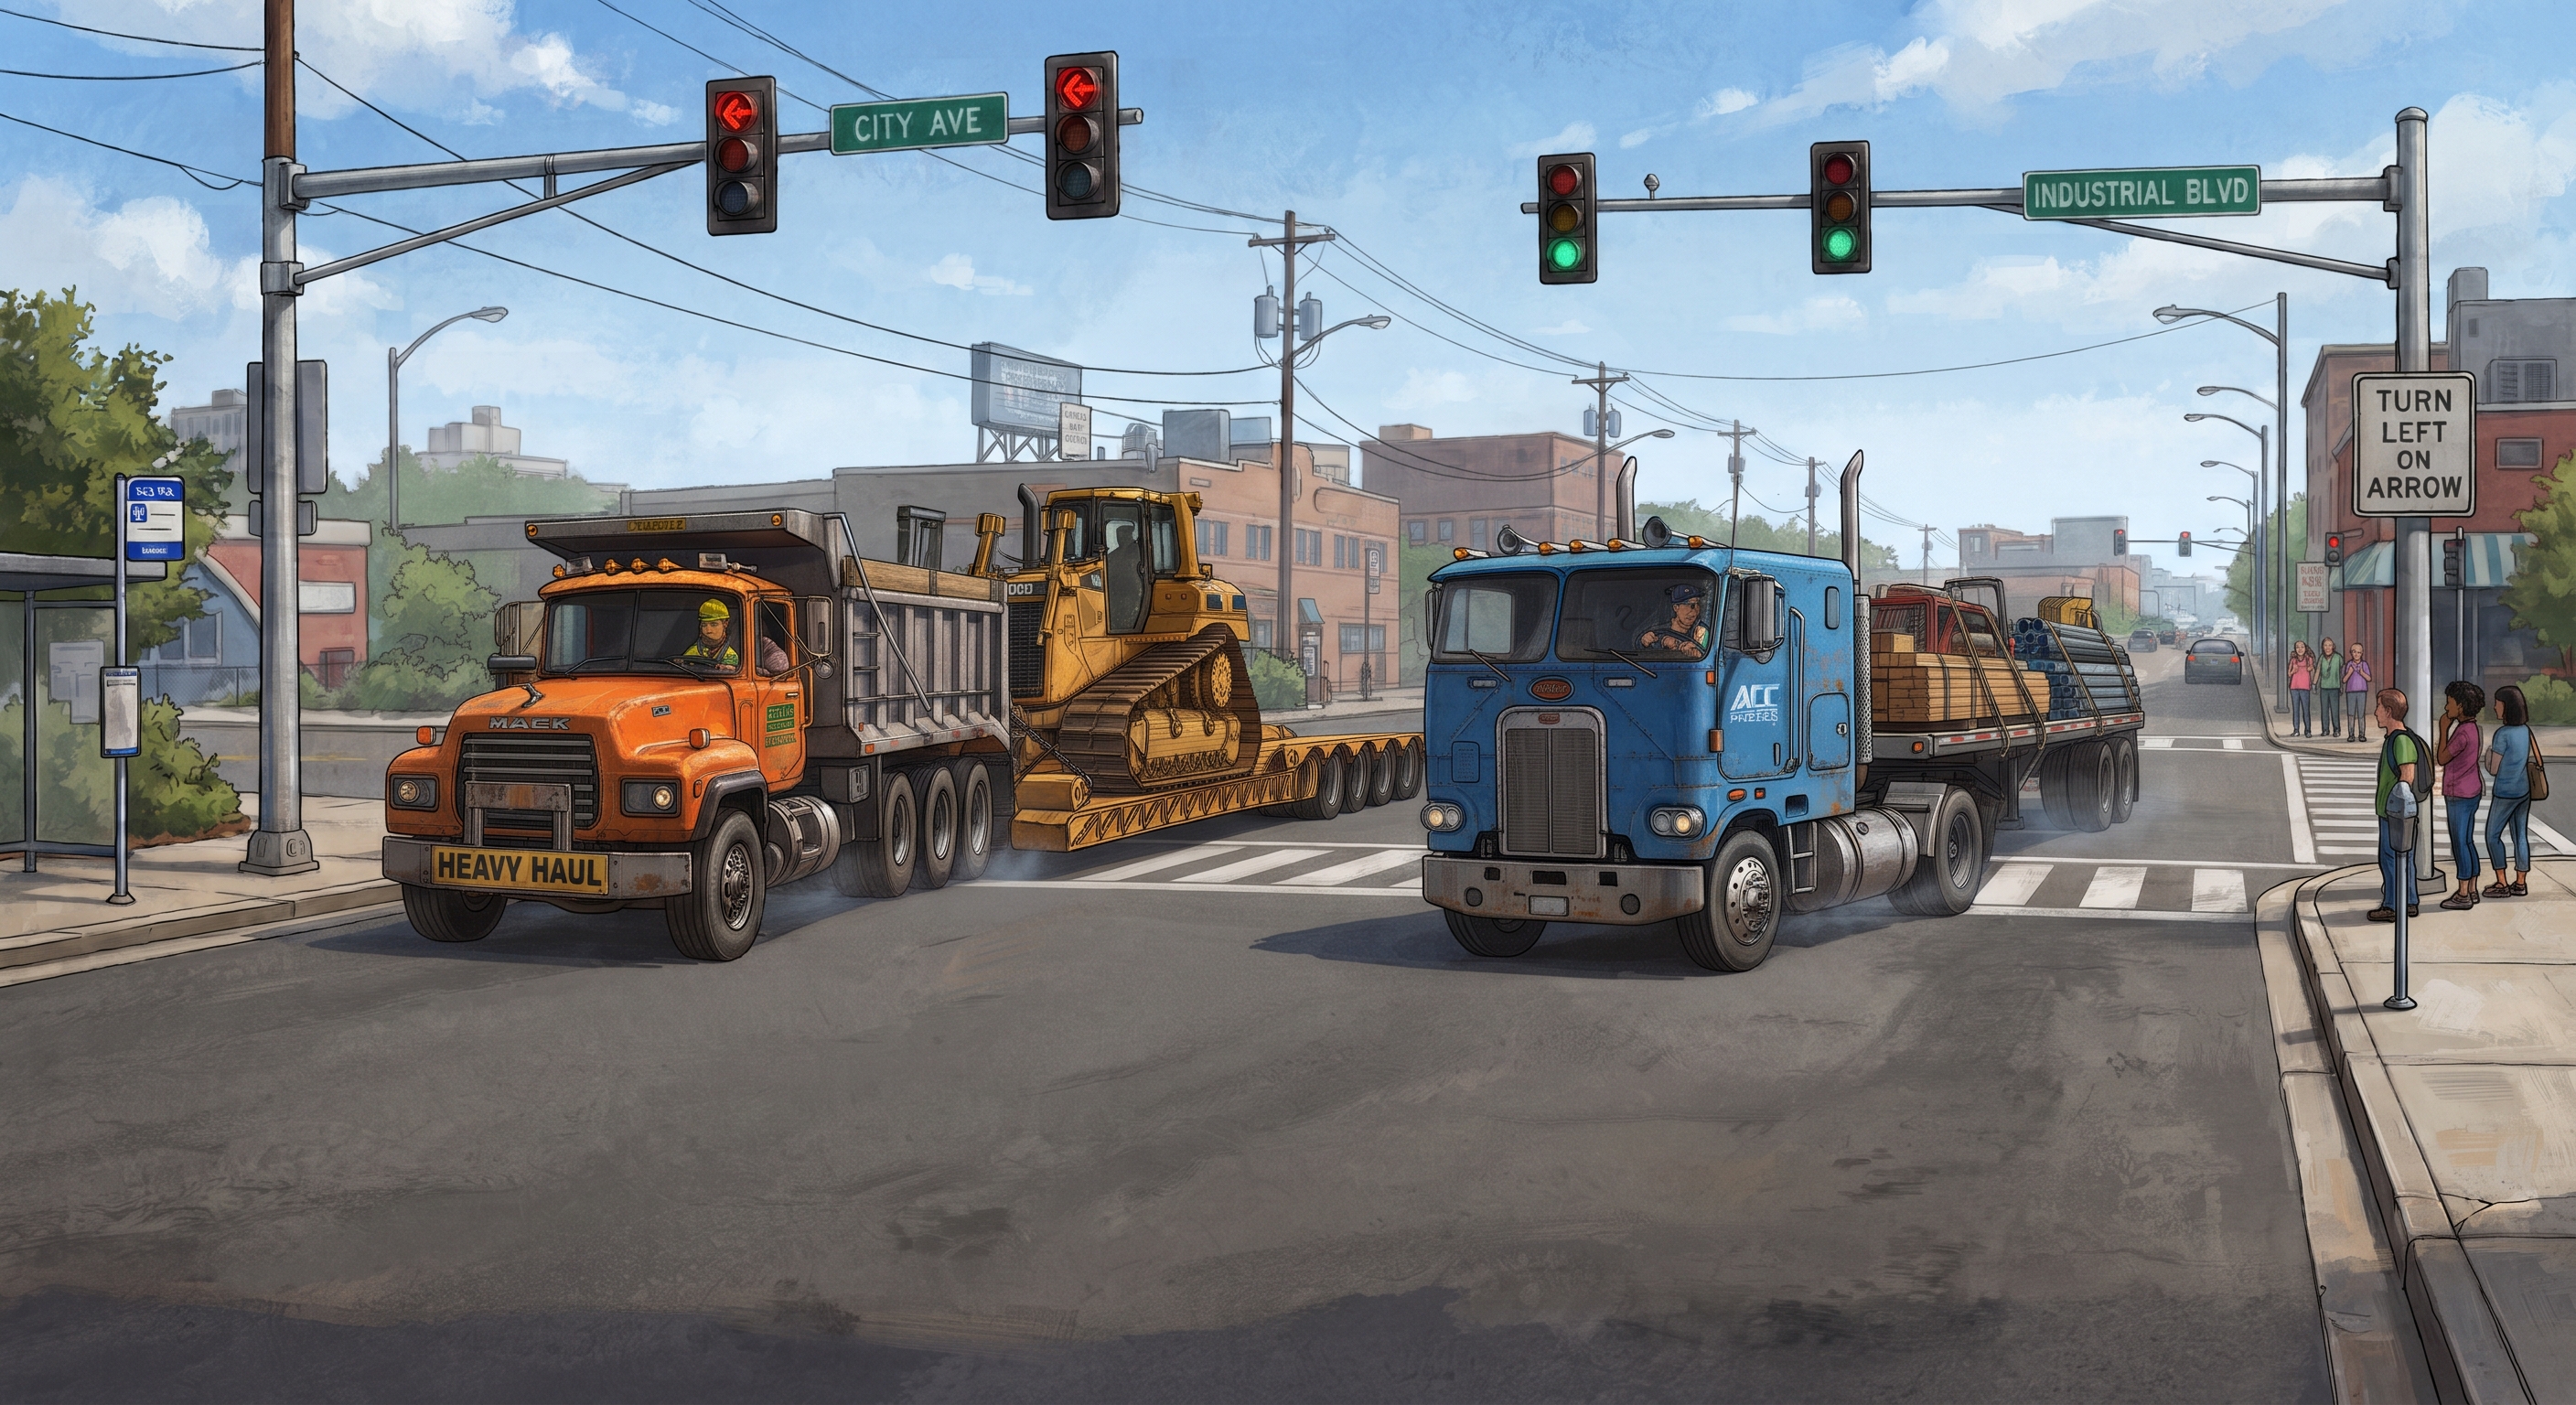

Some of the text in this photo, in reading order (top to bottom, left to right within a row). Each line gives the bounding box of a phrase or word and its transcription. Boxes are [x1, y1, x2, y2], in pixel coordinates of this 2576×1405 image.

[854, 107, 982, 143] CITY AVE
[2034, 177, 2249, 209] INDUSTRIAL BLVD
[2376, 389, 2452, 413] TURN
[2382, 421, 2447, 444] LEFT
[2397, 449, 2431, 470] ON
[2367, 476, 2463, 499] ARROW
[488, 716, 571, 730] MACK
[438, 852, 602, 886] HEAVY HAUL
